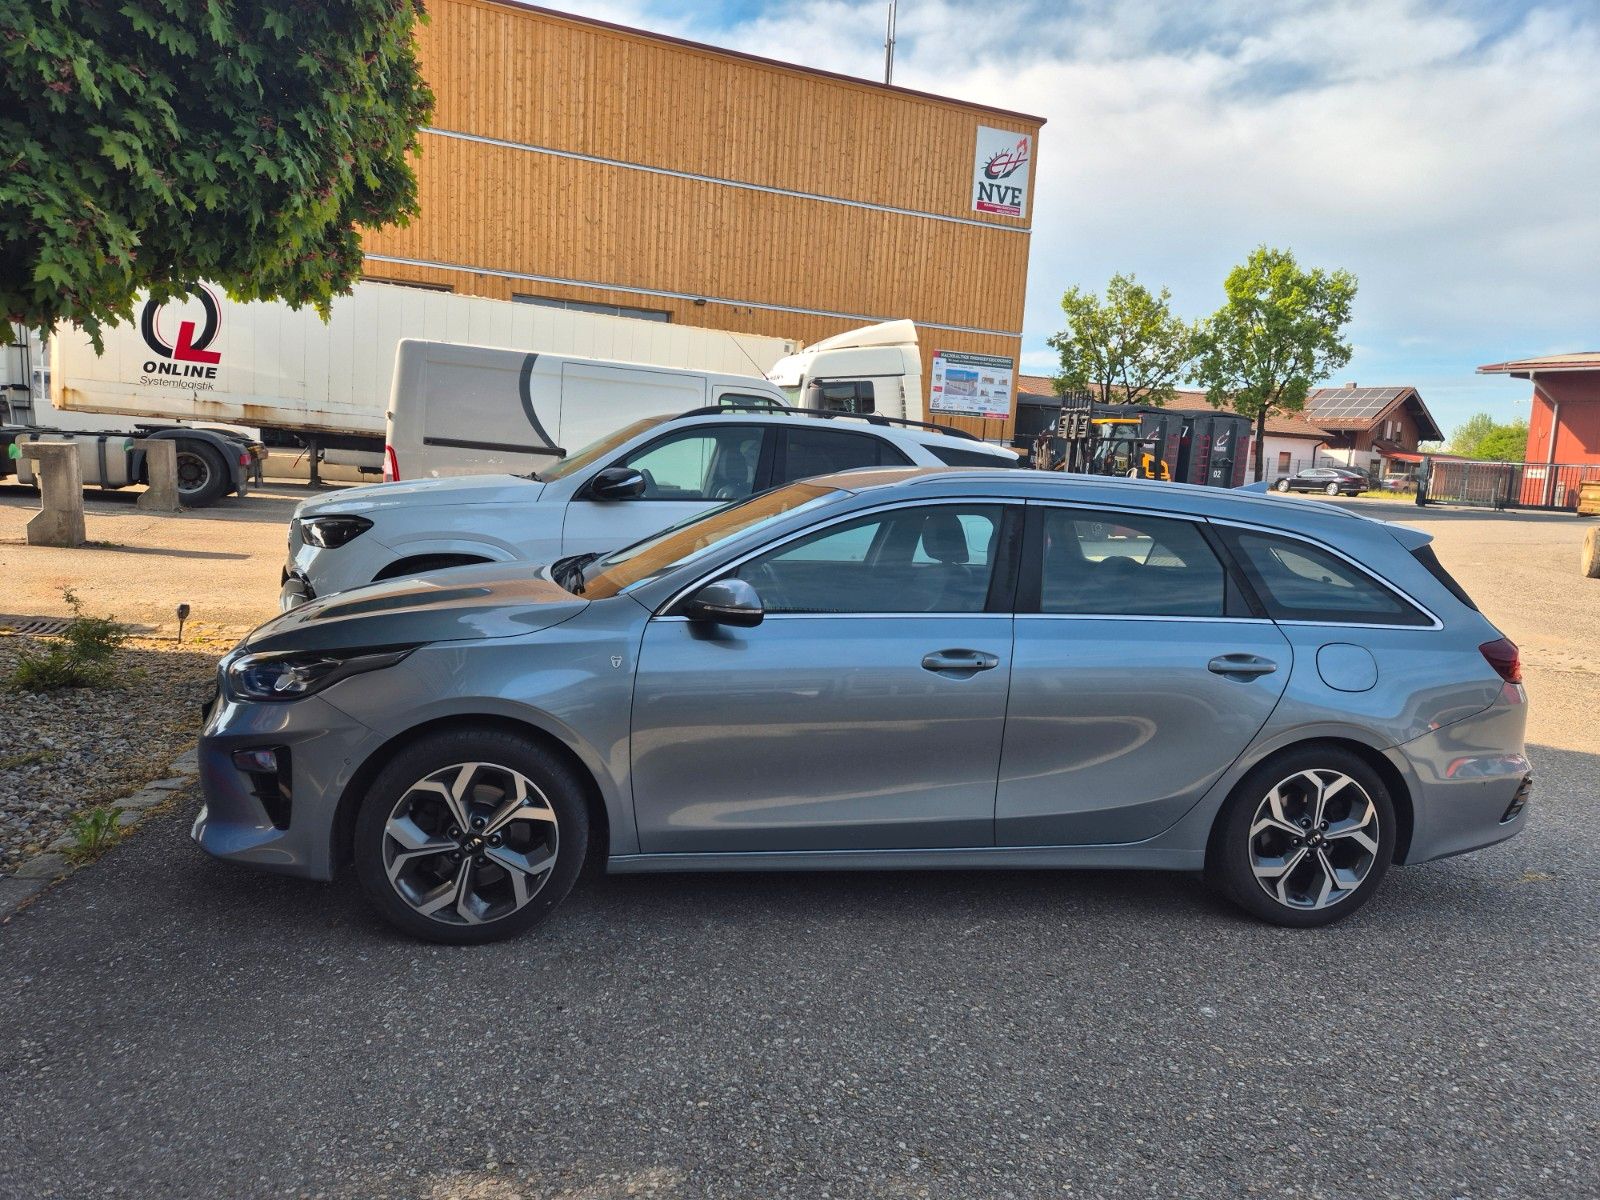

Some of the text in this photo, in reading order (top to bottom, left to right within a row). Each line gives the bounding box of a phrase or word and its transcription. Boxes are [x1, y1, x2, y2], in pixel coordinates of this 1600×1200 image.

[977, 181, 1022, 206] NVE
[143, 361, 218, 379] ONLINE
[139, 375, 214, 391] Systemlogistik
[1213, 470, 1222, 478] 02
[464, 838, 482, 851] KIA
